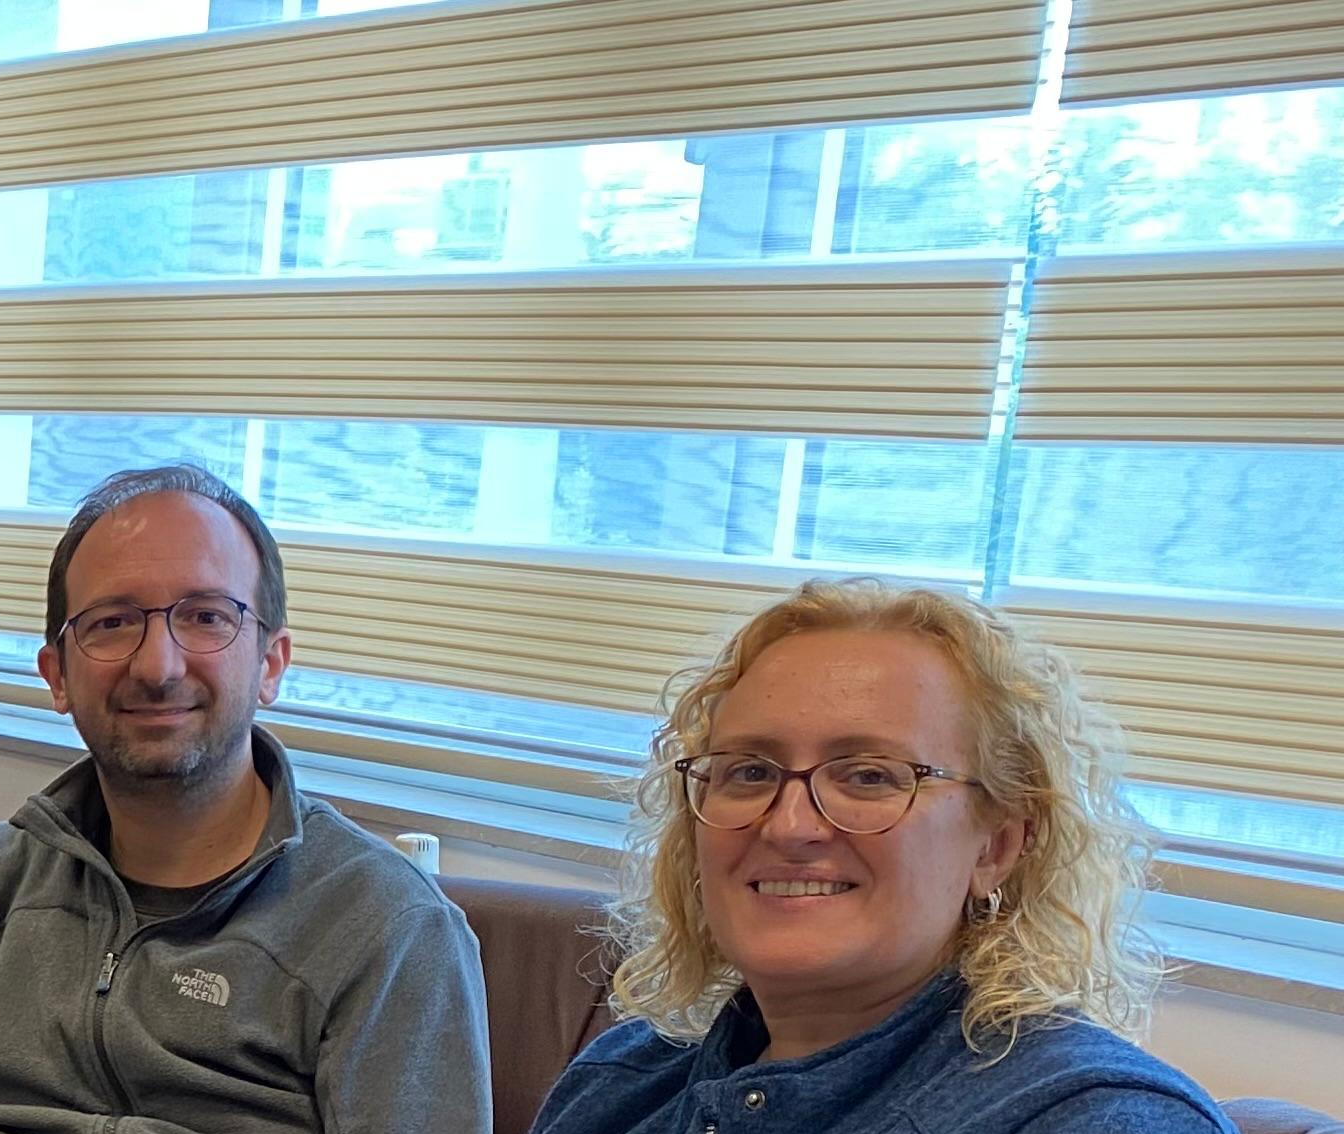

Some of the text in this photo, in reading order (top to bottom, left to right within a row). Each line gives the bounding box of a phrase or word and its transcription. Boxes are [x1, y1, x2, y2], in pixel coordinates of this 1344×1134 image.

[172, 973, 213, 992] NORTH
[193, 968, 217, 983] THE
[178, 986, 209, 1001] FACE
